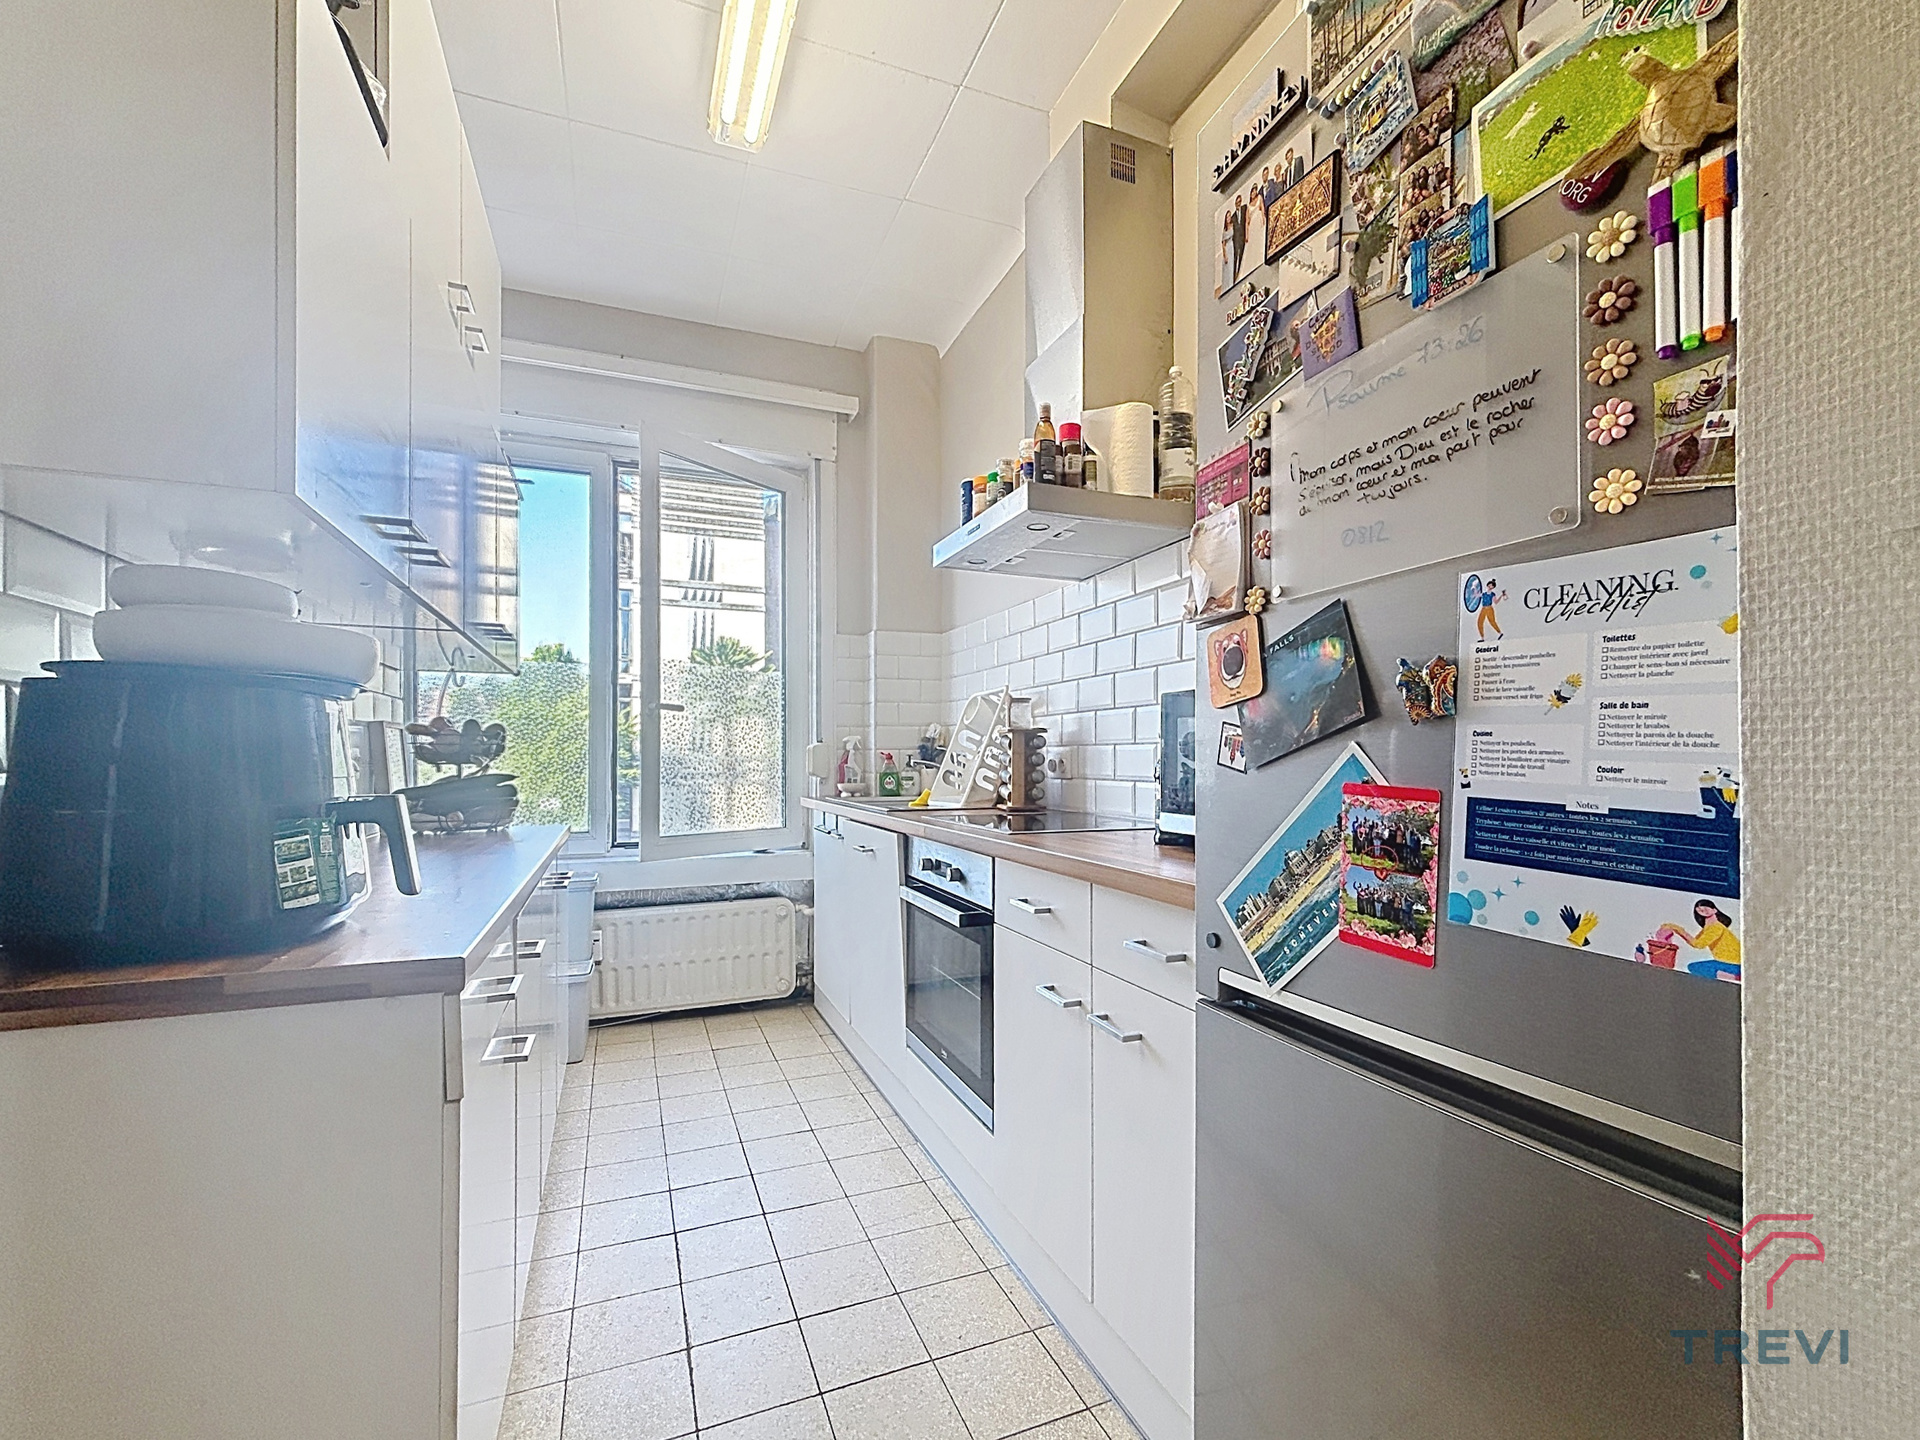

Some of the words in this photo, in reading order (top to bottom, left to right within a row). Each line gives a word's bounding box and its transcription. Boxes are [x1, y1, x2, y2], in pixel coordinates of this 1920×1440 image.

[1595, 0, 1726, 37] HOLLAND
[1341, 45, 1373, 79] COSTA
[1316, 339, 1343, 363] FOOD
[1306, 366, 1406, 416] Psaume
[1330, 448, 1361, 469] corps
[1366, 442, 1378, 453] et
[1382, 426, 1417, 448] mon
[1473, 369, 1541, 412] peuvent
[1356, 455, 1392, 477] mais
[1395, 440, 1434, 460] Dieu
[1440, 427, 1459, 441] est
[1467, 419, 1478, 430] le
[1487, 397, 1534, 423] rocher
[1317, 490, 1349, 505] mon
[1393, 465, 1406, 476] et
[1411, 454, 1440, 471] ma
[1446, 433, 1480, 461] part
[1489, 418, 1523, 444] pour
[1342, 520, 1389, 547] 0812
[1544, 583, 1661, 623] Checklist
[1269, 634, 1294, 654] FALLS
[1603, 634, 1636, 643] Toilettes
[1678, 640, 1705, 648] toilette
[1476, 646, 1498, 654] Général
[1530, 652, 1555, 660] poubelles
[1640, 652, 1671, 660] intérieur
[1691, 649, 1708, 657] javel
[1646, 660, 1679, 668] sens-bon
[1646, 670, 1674, 678] planche
[1600, 702, 1617, 710] Salle
[1597, 766, 1624, 774] Couloir
[1604, 776, 1632, 784] Nettoyer
[1576, 801, 1599, 809] Notes
[1475, 830, 1497, 839] Nettoyer
[1526, 837, 1549, 845] vaisselle
[1558, 840, 1574, 848] vitres
[1630, 835, 1664, 843] semaines
[1557, 854, 1572, 862] mois
[1618, 863, 1645, 871] octobre
